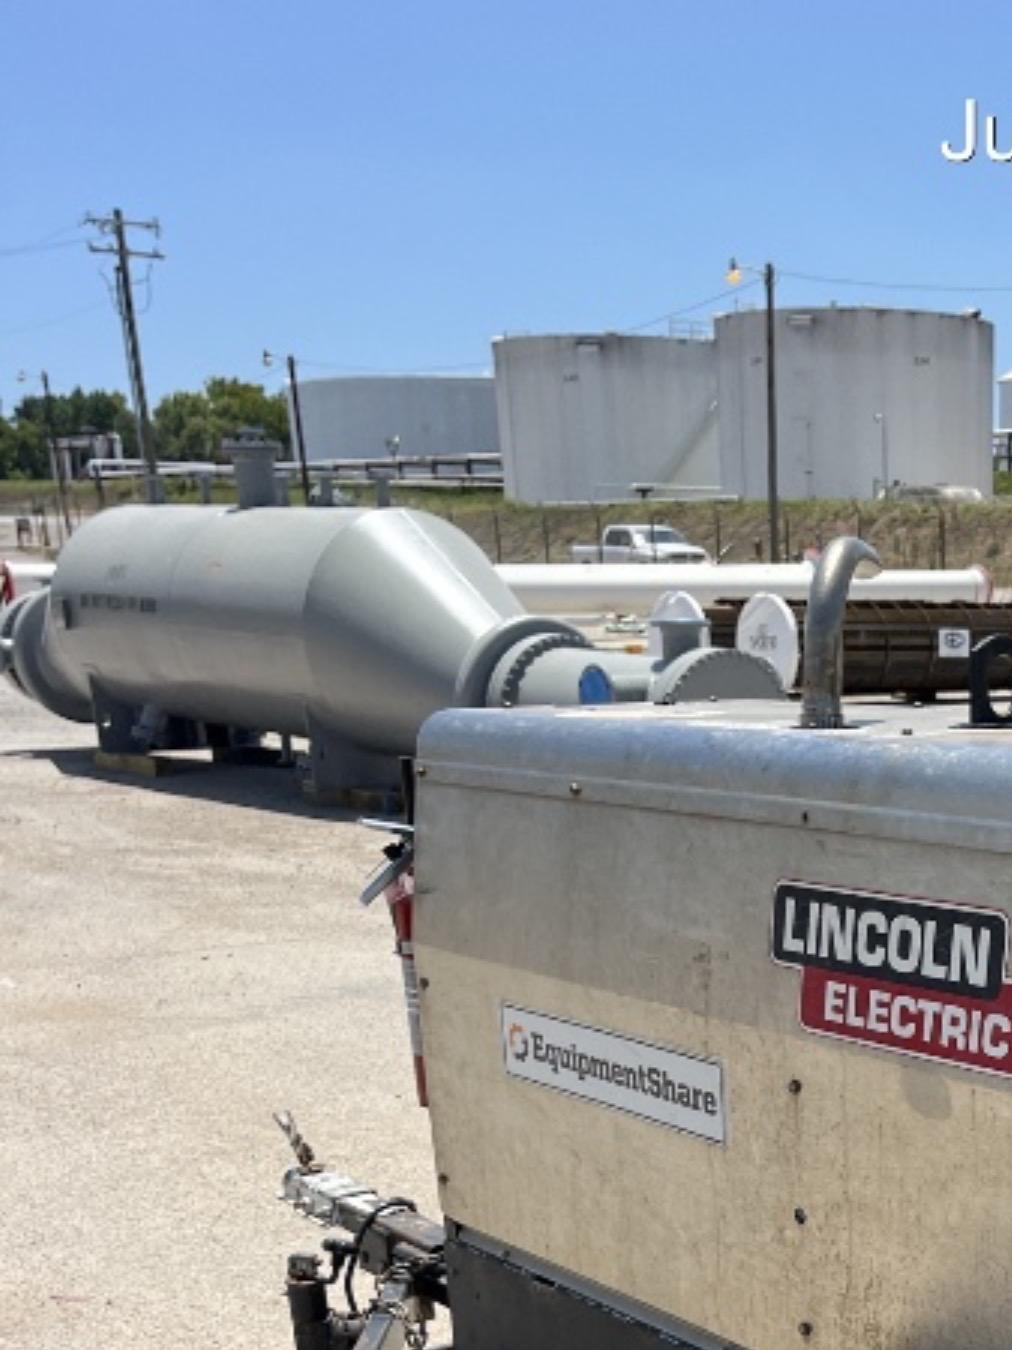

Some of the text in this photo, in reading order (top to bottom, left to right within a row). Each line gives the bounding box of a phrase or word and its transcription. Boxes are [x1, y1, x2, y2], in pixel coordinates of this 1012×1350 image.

[781, 896, 992, 988] LINCOLN
[823, 980, 1012, 1060] ELECTRIC
[530, 1031, 718, 1116] EquipmentShare
